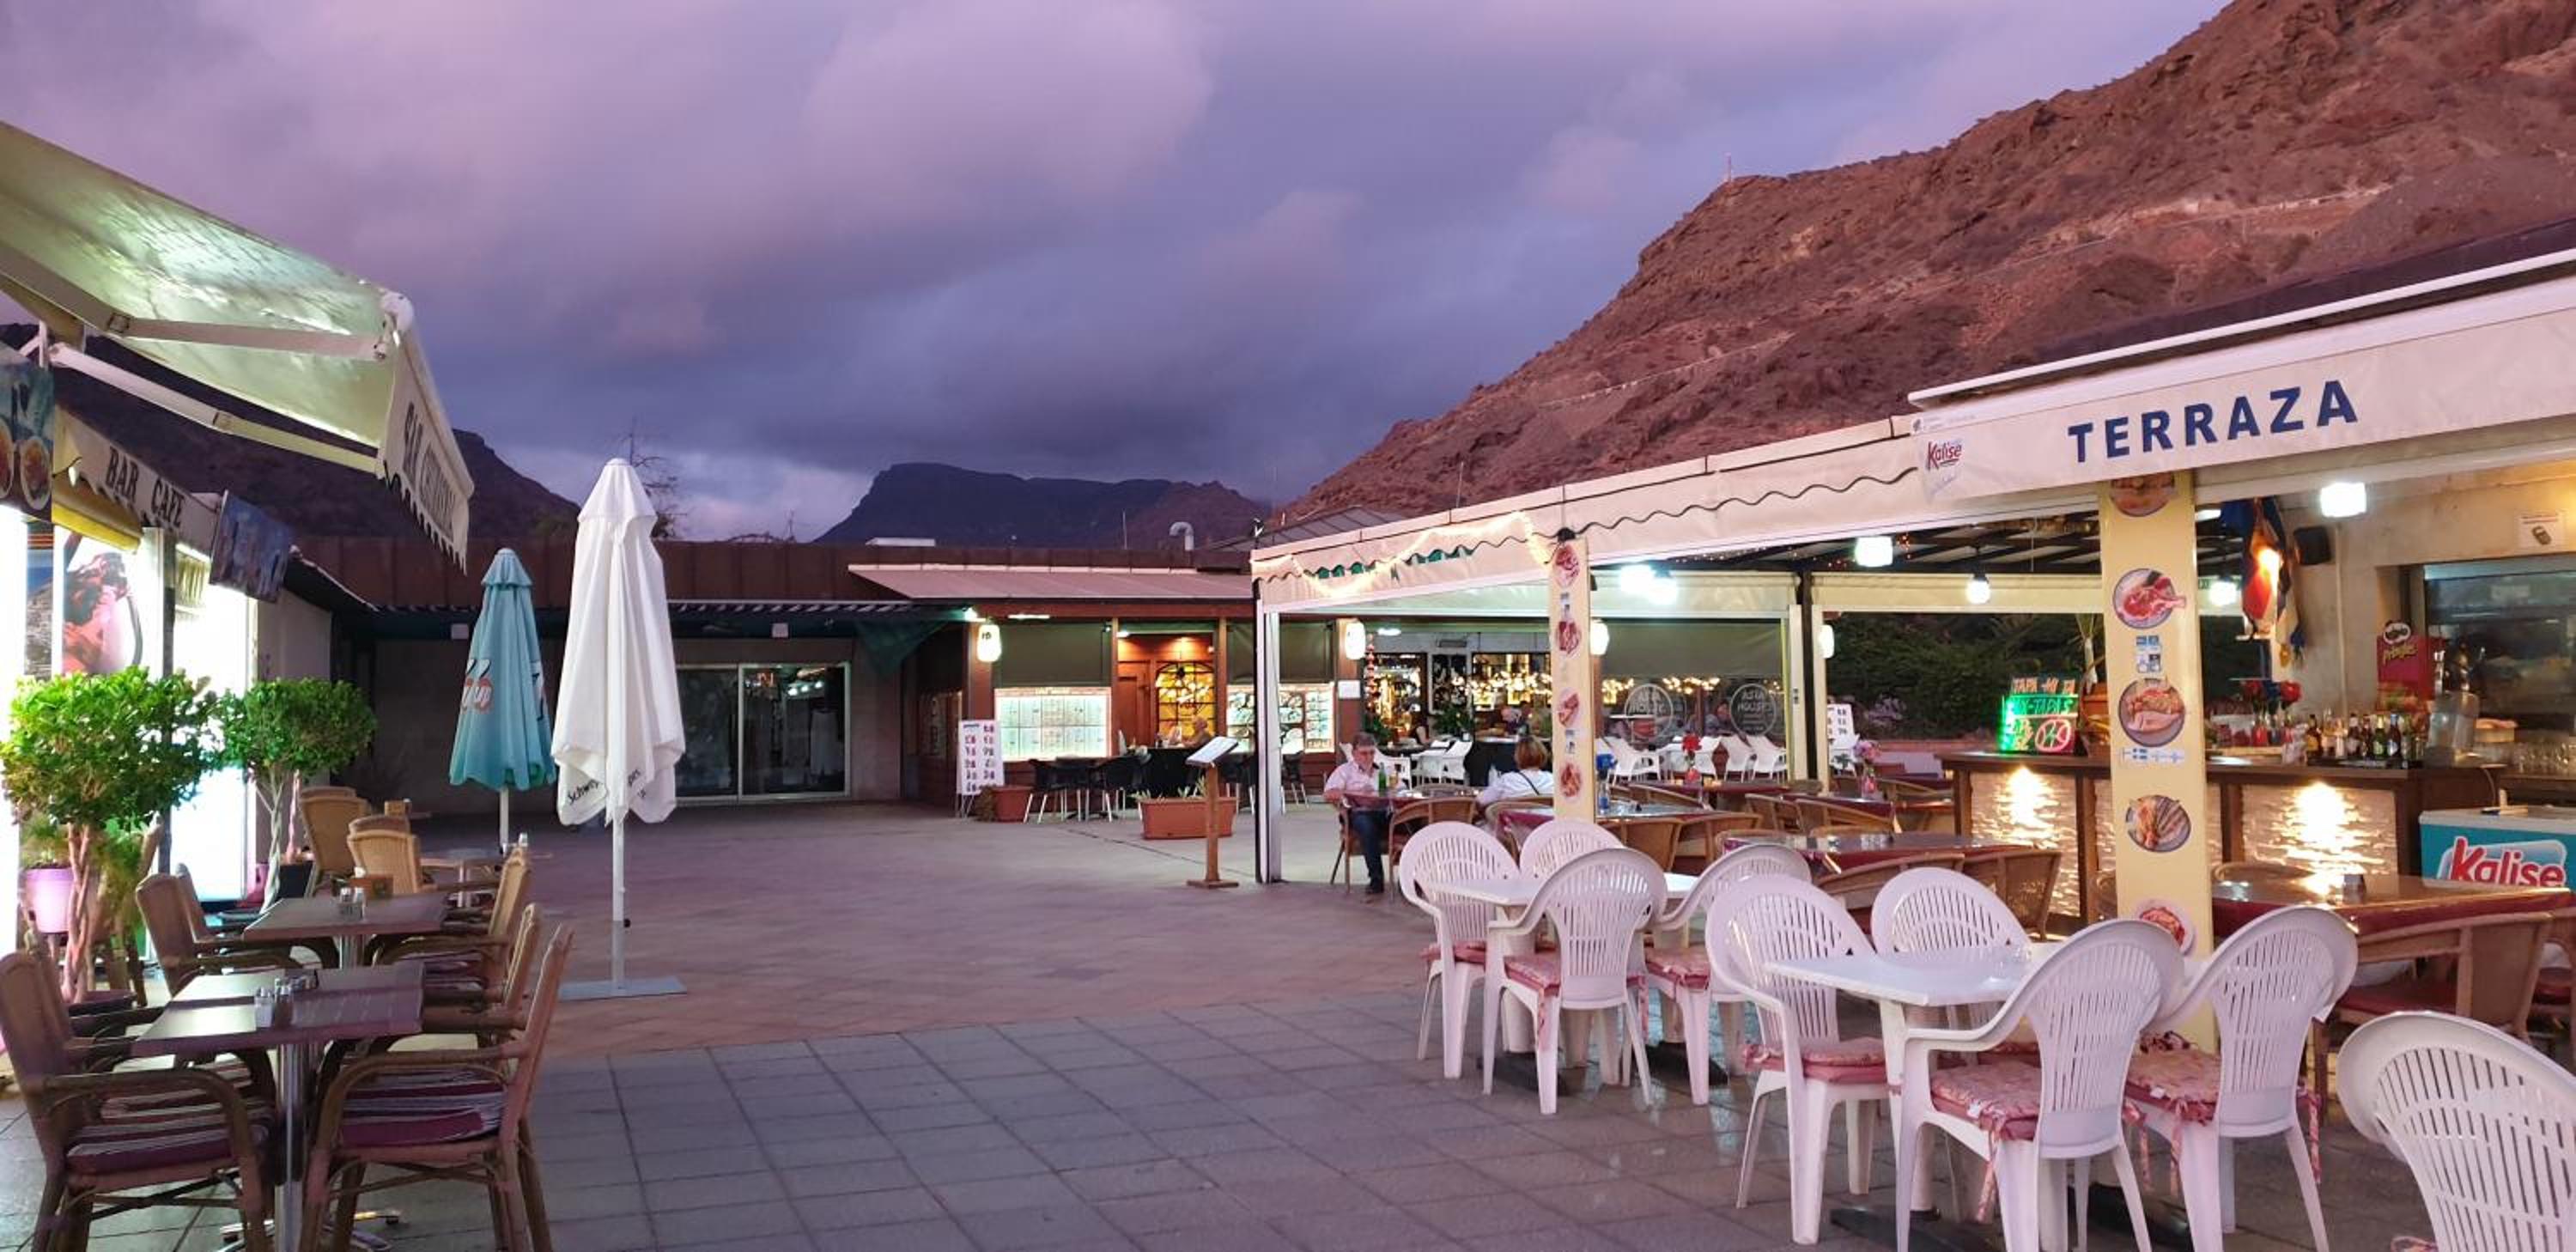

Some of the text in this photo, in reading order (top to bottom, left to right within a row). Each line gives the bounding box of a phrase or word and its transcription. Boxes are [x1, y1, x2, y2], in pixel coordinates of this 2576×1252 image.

[2067, 380, 2359, 464] TERRAZA
[106, 446, 185, 529] BAR CAFE
[1926, 441, 1963, 471] Kalise
[2451, 836, 2564, 887] Kalise
